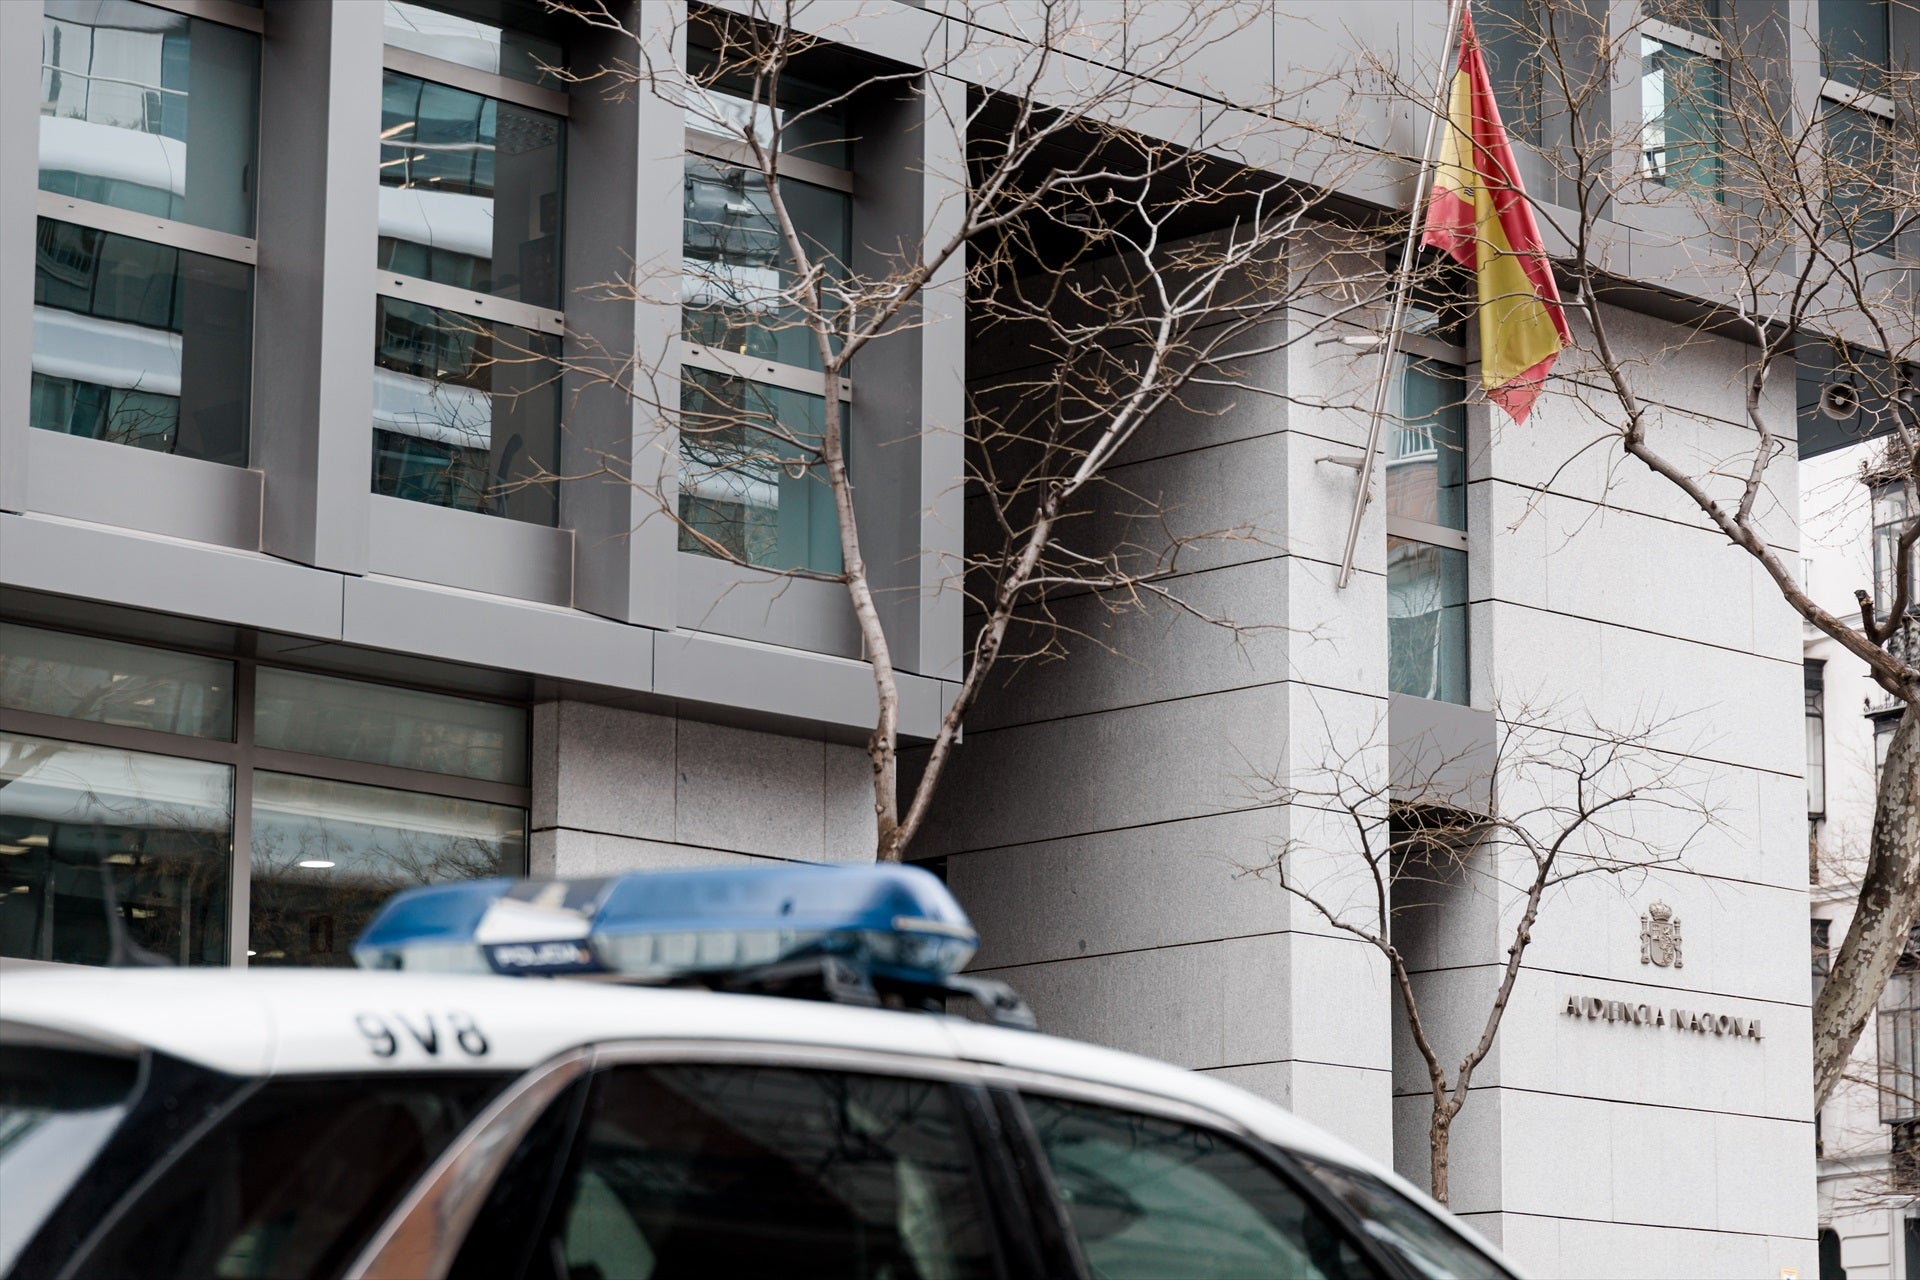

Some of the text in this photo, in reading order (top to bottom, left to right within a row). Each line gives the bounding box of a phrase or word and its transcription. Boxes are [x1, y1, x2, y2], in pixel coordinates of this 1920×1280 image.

[354, 1010, 489, 1058] 9V8
[1561, 994, 1766, 1040] AUDIENCIA NACIONAL
